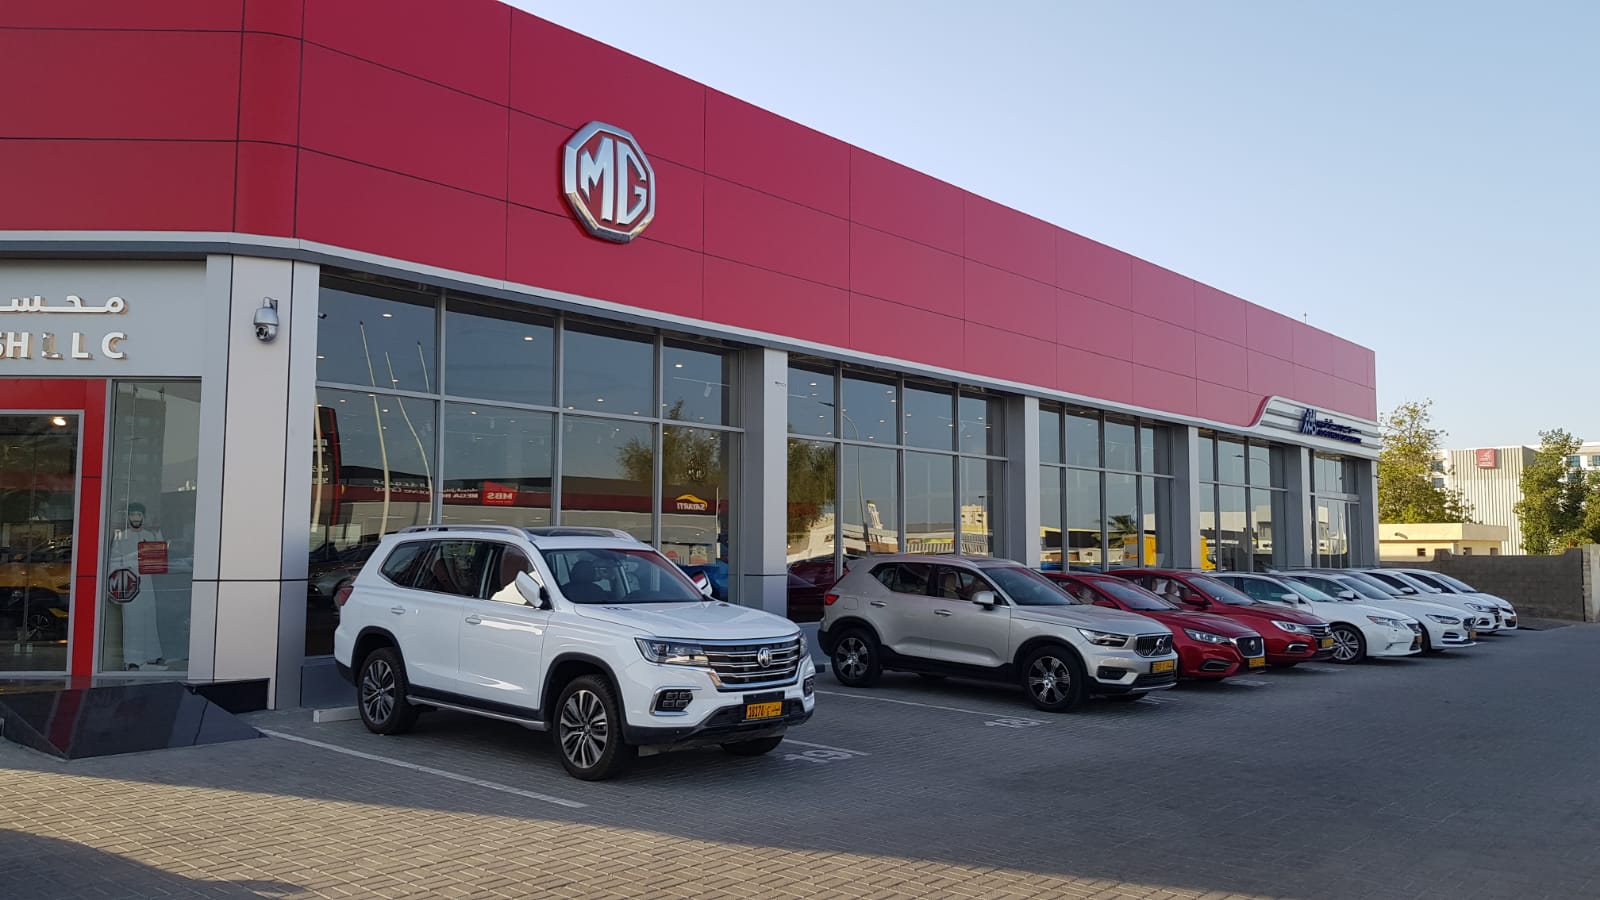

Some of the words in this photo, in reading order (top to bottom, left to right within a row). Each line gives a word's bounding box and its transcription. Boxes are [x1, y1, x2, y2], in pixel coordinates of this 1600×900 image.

[580, 136, 647, 225] MG
[0, 295, 125, 313] محس
[0, 331, 31, 359] H
[784, 749, 853, 763] 19
